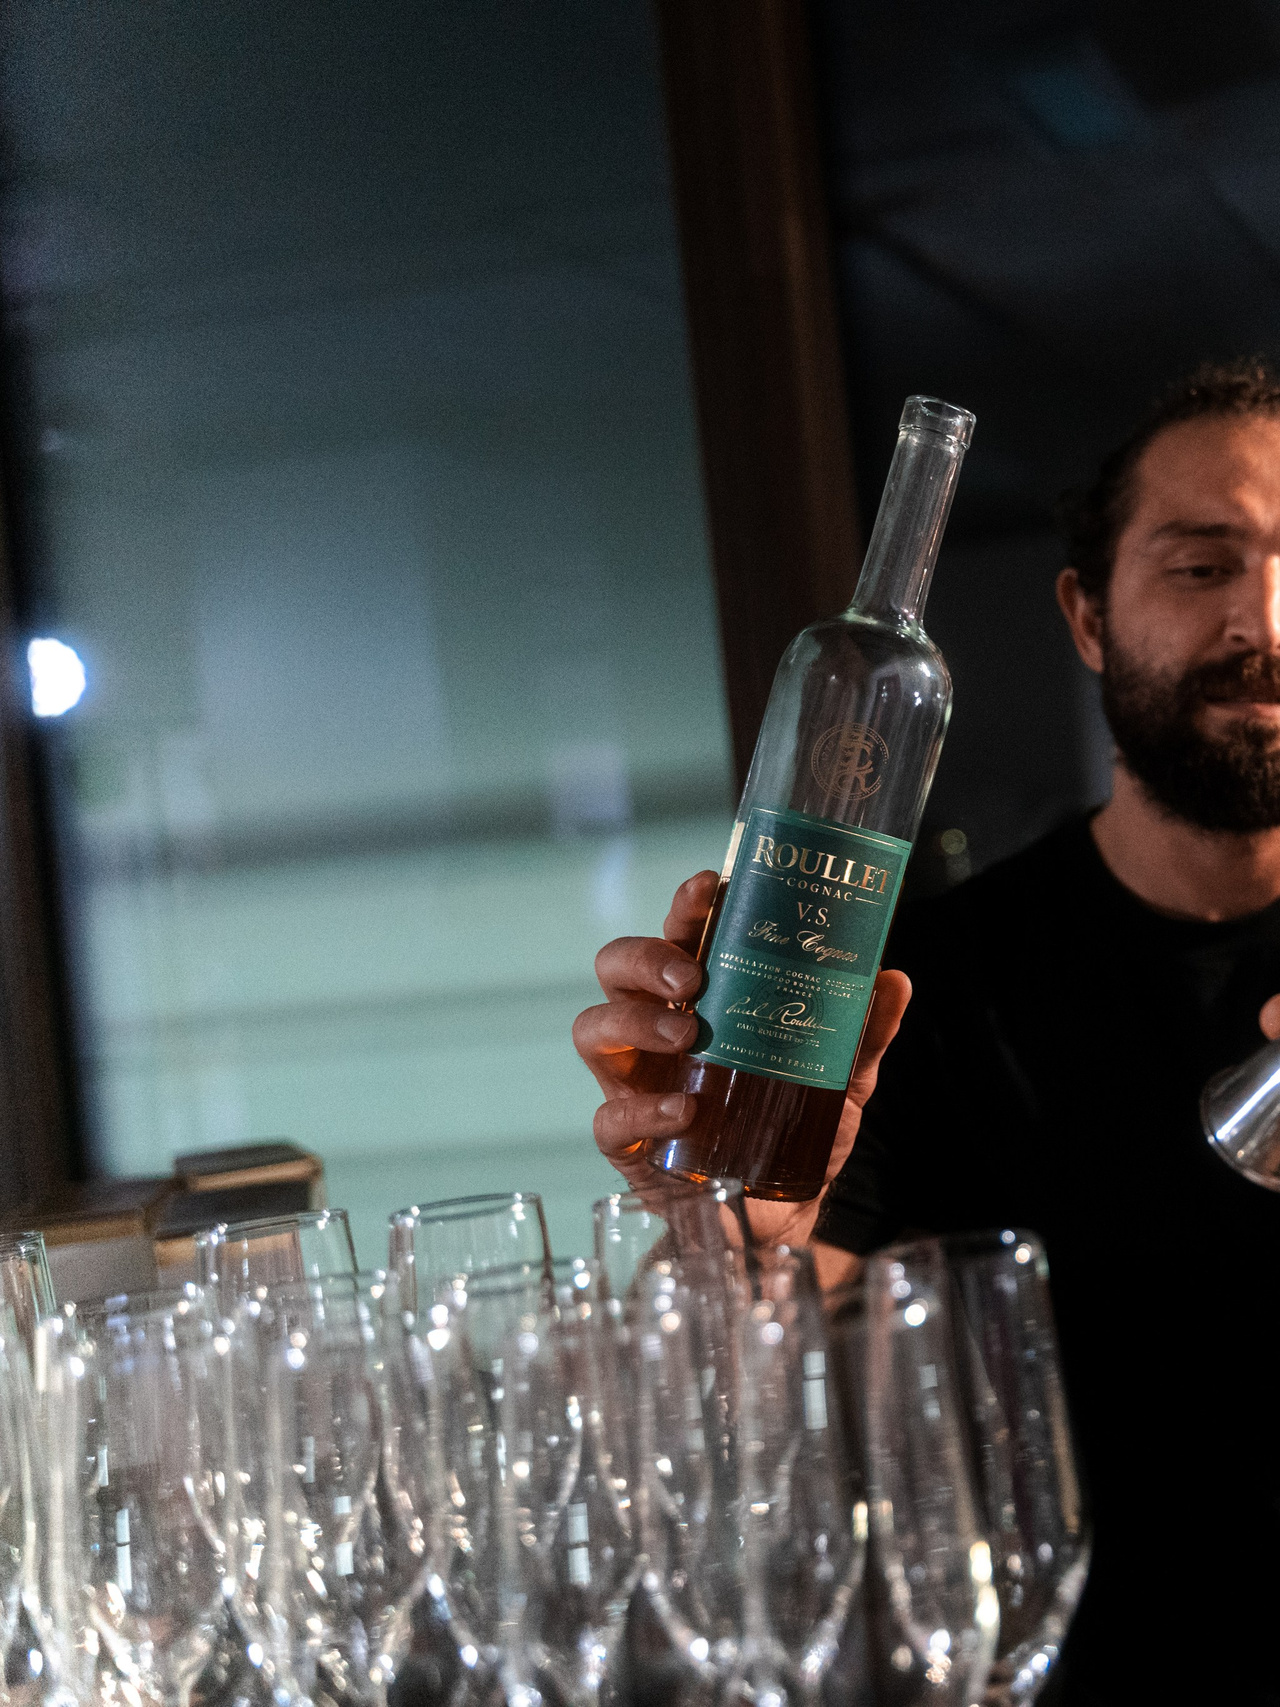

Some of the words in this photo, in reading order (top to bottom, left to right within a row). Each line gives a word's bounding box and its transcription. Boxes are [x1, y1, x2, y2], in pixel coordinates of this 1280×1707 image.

[752, 835, 892, 894] ROULLET
[786, 877, 853, 902] COGNAC
[797, 901, 831, 928] V.S.
[748, 920, 790, 945] Fine
[796, 930, 859, 963] Cognac
[719, 952, 781, 974] APPELLATION
[785, 969, 821, 984] COGNAC
[776, 985, 813, 998] FRANCE
[736, 1022, 756, 1032] PAUL
[757, 1026, 793, 1042] ROULLET
[770, 1054, 783, 1063] DE
[787, 1059, 825, 1073] FRANCE
